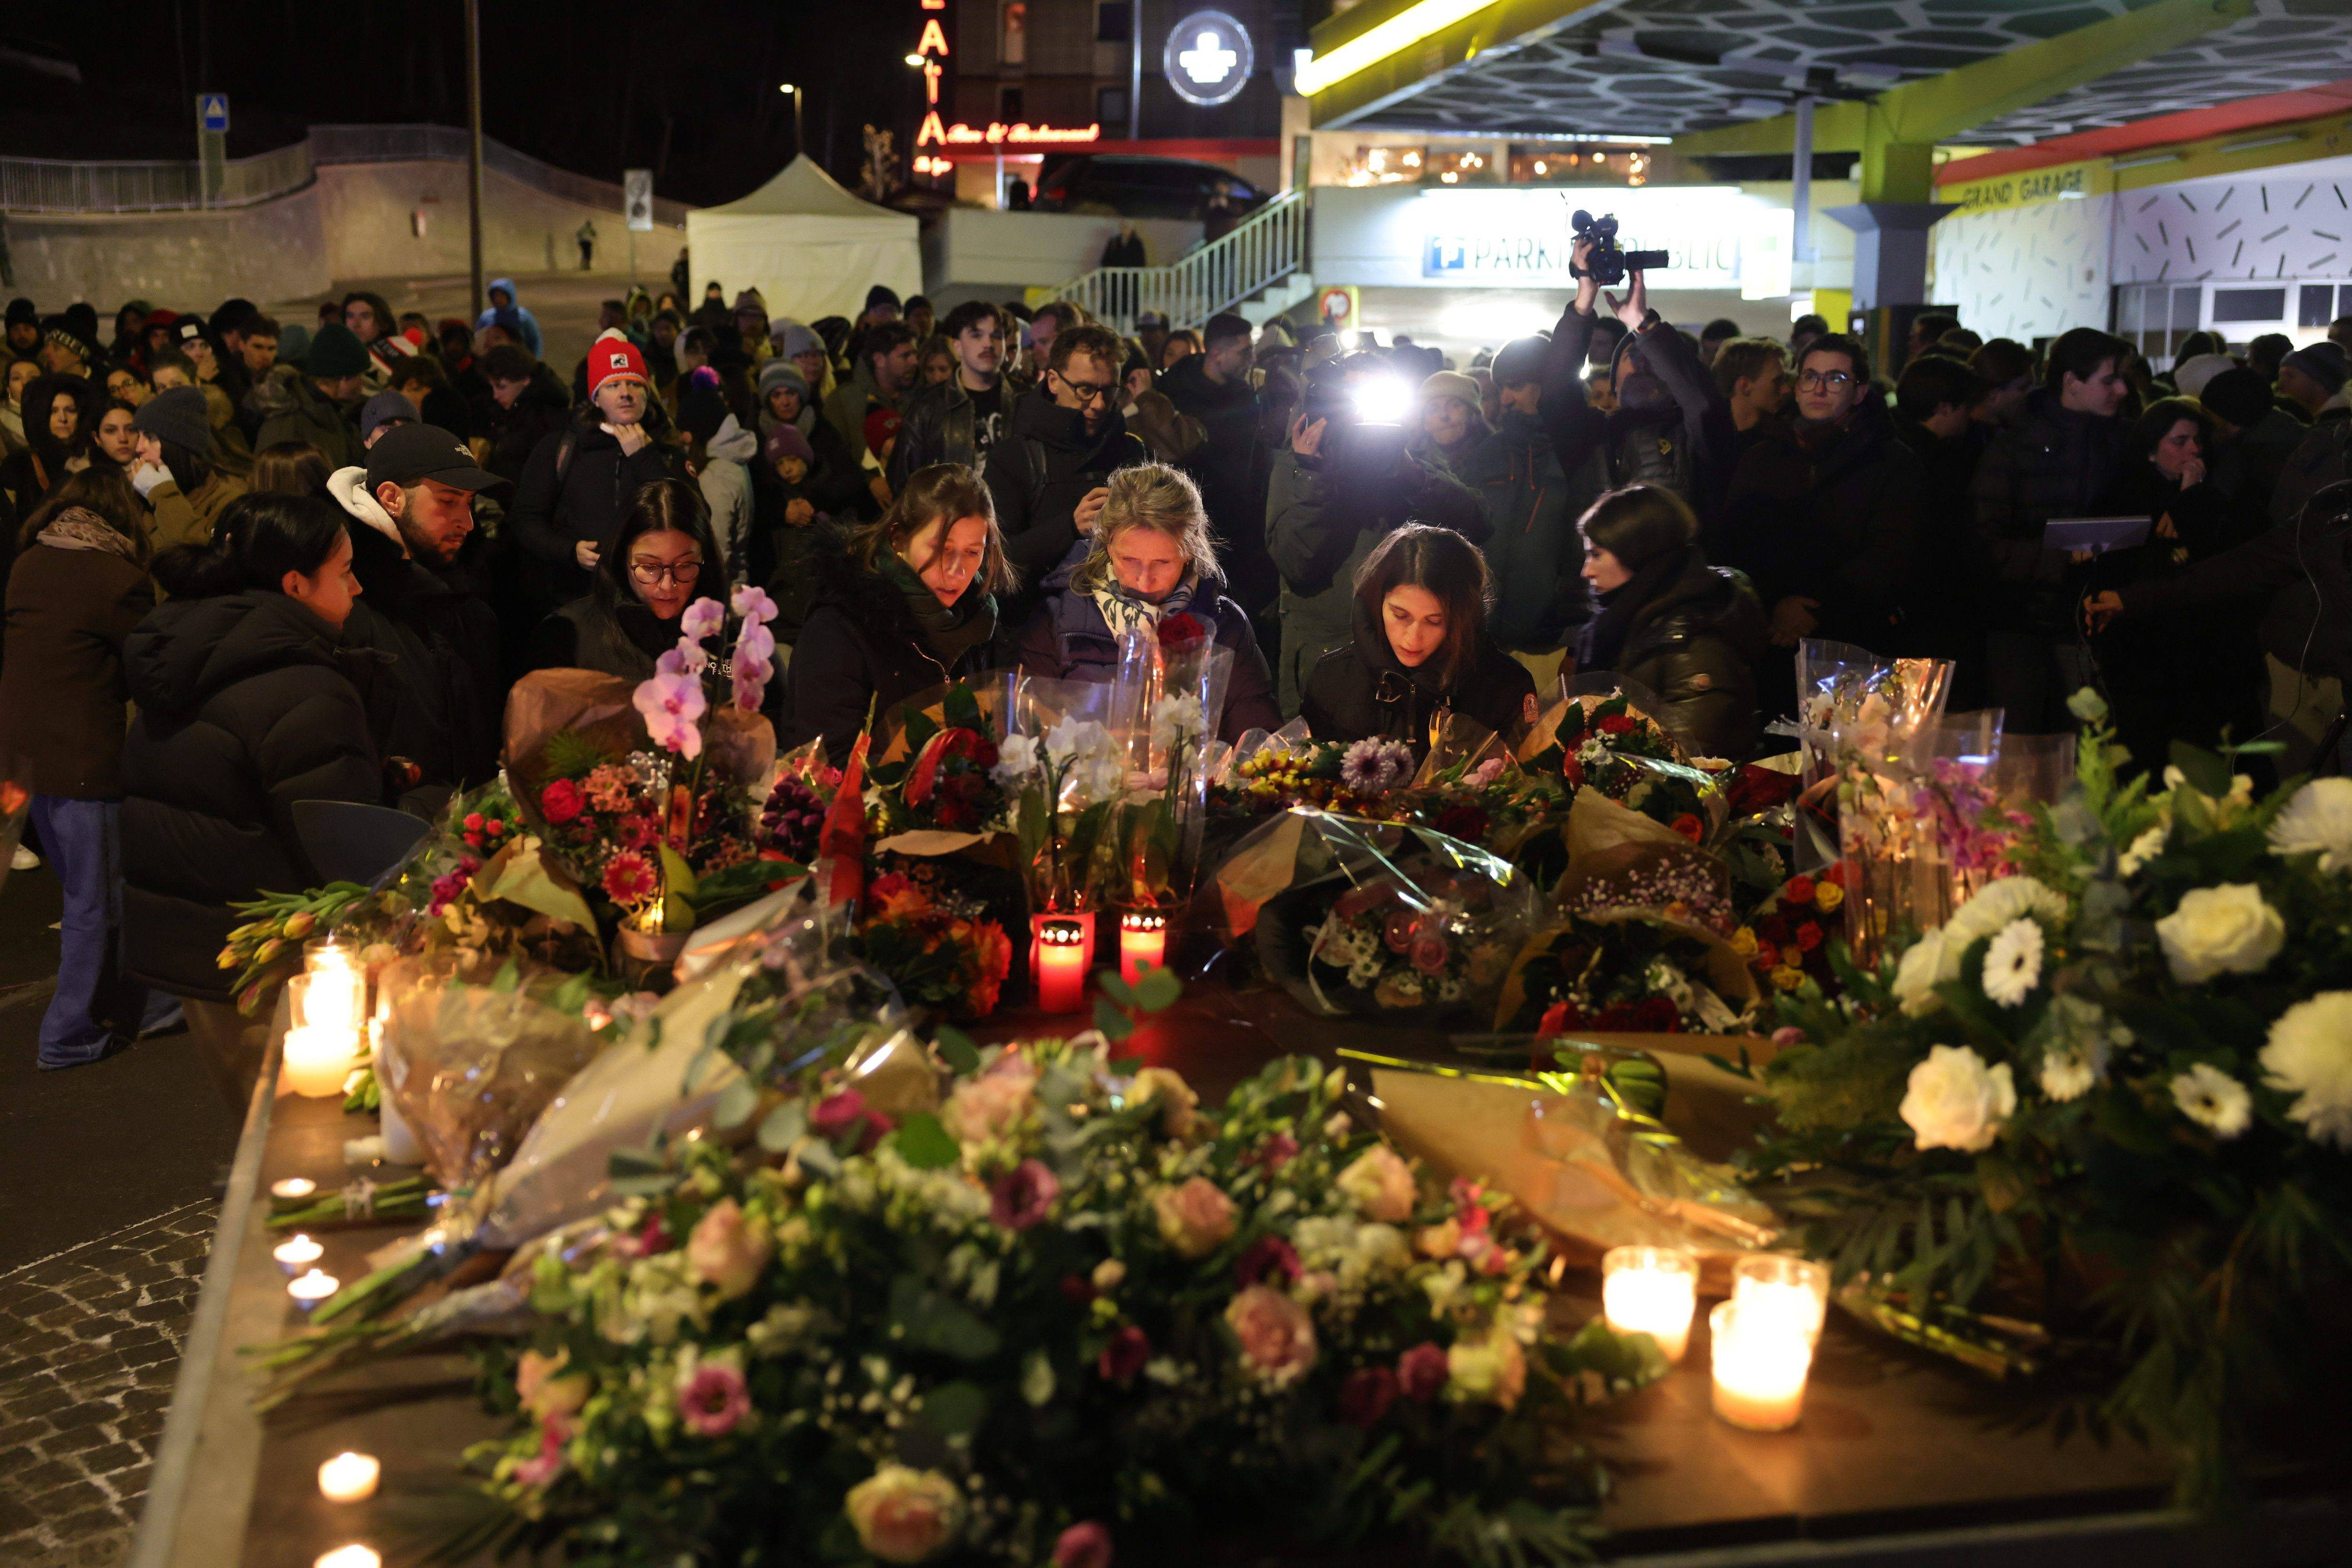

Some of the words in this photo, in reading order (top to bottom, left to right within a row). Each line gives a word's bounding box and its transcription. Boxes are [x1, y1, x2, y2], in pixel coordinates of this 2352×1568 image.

[1961, 182, 2013, 208] GRAND
[1475, 238, 1573, 269] PARKI
[705, 662, 732, 671] NOTH
